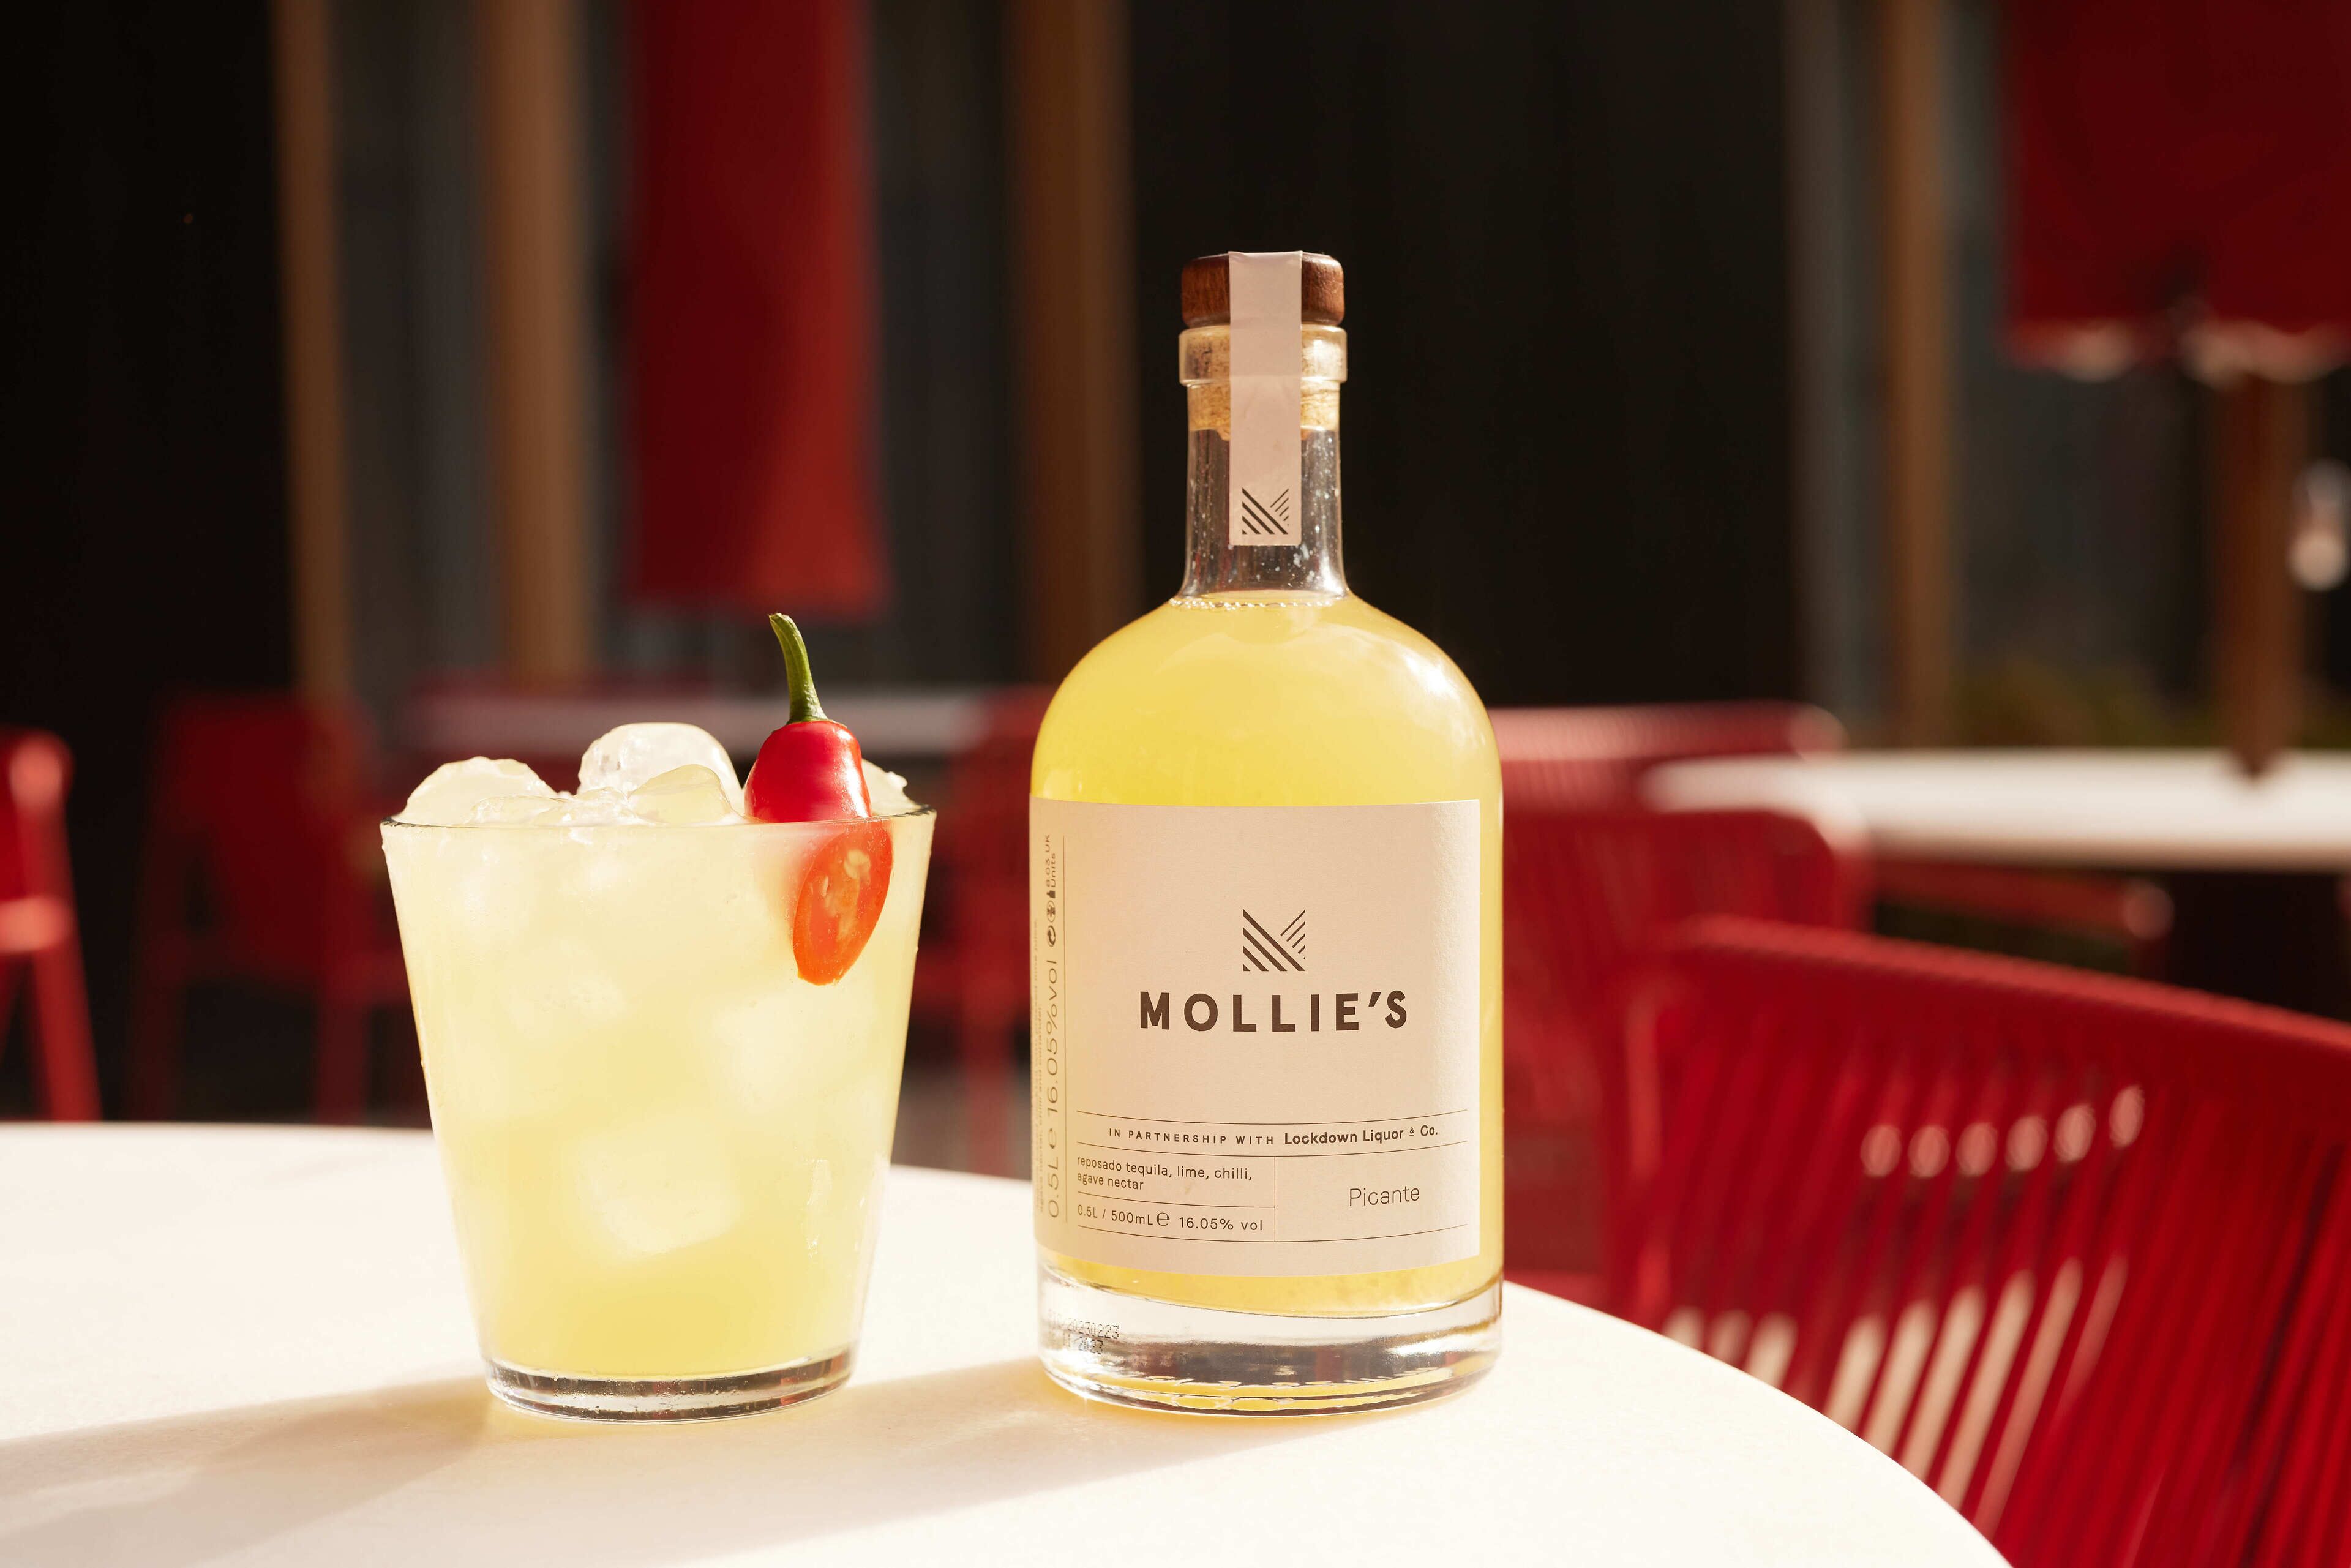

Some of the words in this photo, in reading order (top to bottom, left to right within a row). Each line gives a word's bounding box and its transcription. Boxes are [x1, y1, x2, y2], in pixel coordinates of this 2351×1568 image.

[1140, 990, 1407, 1032] MOLLIE'S
[1109, 1127, 1120, 1138] IN
[1128, 1130, 1227, 1144] PARTNERSHIP
[1235, 1136, 1273, 1145] WITH
[1284, 1131, 1357, 1145] Lockdown
[1362, 1128, 1404, 1144] Liquor
[1420, 1124, 1438, 1137] Co.
[1078, 1157, 1122, 1171] reposado
[1125, 1162, 1172, 1178] tequila,
[1177, 1165, 1209, 1180] lime,
[1214, 1167, 1252, 1181] chilli,
[1078, 1172, 1104, 1185] agave
[1108, 1175, 1144, 1190] nectar
[1048, 1156, 1059, 1218] 0.5L
[1349, 1185, 1420, 1207] Picante
[1077, 1204, 1098, 1218] 0.5L
[1179, 1215, 1234, 1231] 16.05%
[1240, 1219, 1262, 1231] vol
